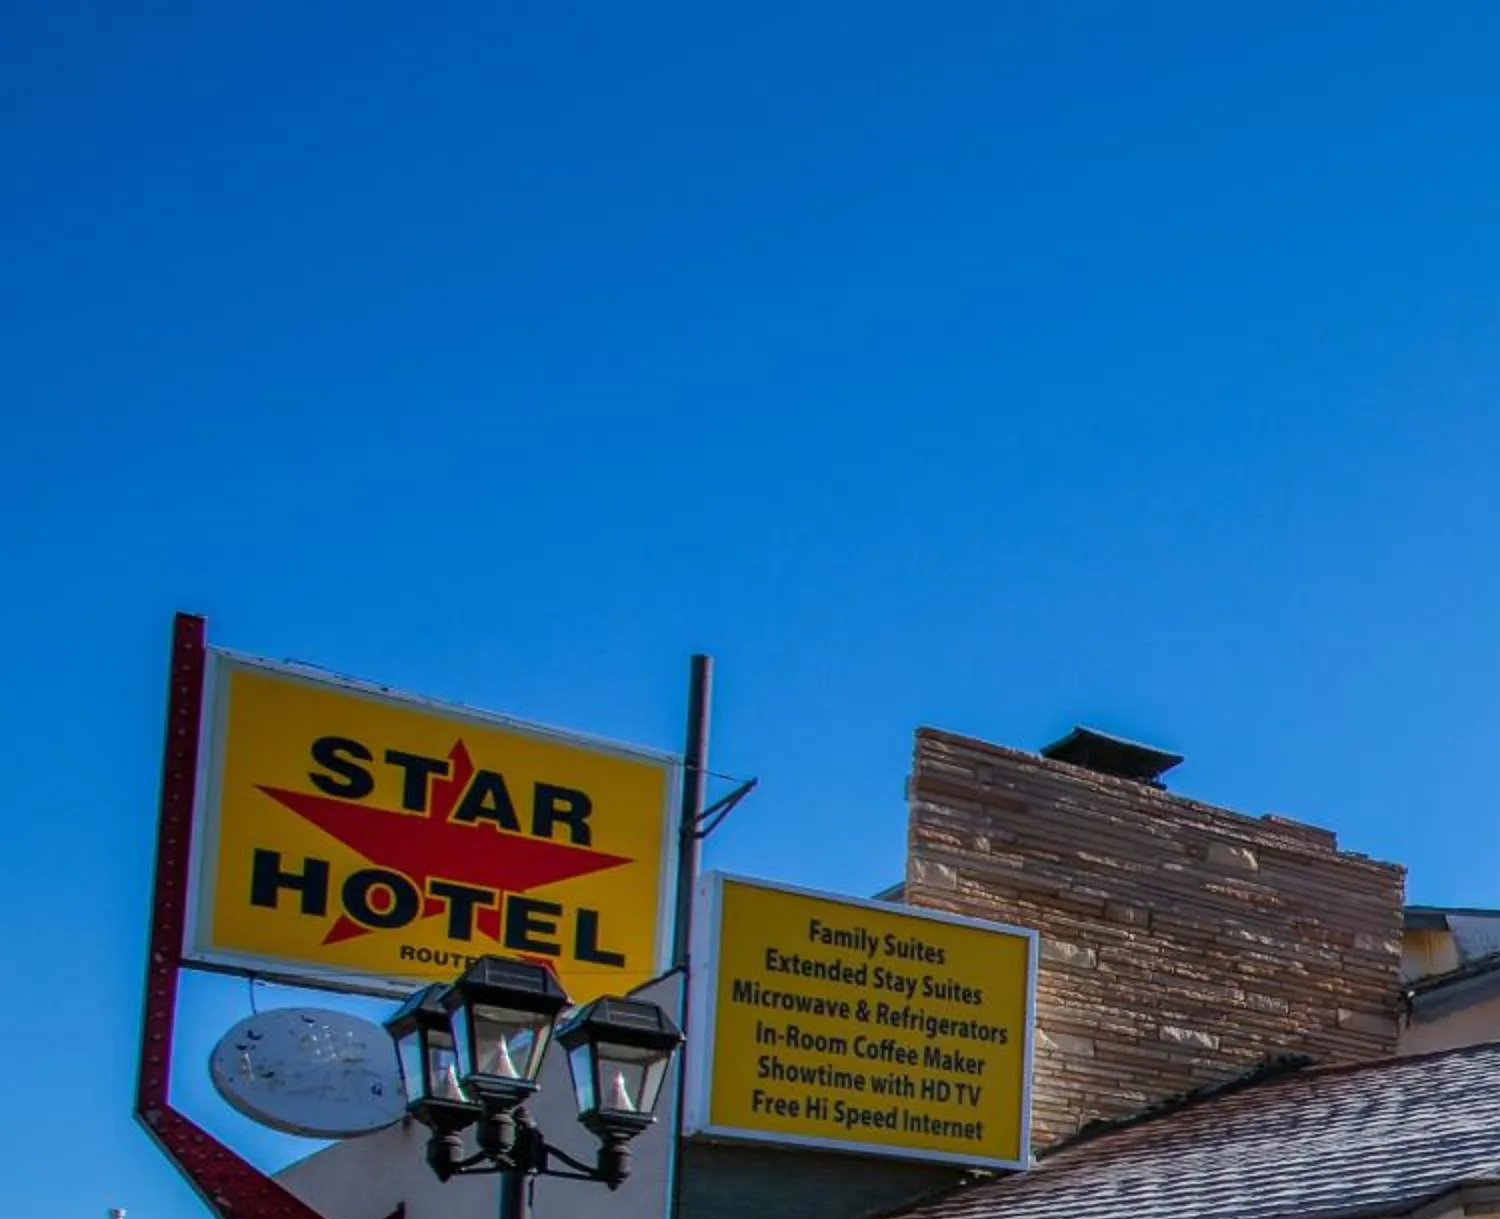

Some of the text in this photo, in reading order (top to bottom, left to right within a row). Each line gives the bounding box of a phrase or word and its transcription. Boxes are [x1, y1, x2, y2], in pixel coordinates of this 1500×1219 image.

[308, 736, 593, 847] STAR
[250, 848, 625, 968] HOTEL
[809, 919, 945, 965] Family Suites
[765, 948, 982, 1006] Extended Stay Suites
[732, 979, 1008, 1045] Microwave & Refrigerators
[755, 1021, 985, 1076] In-Room Coffee Maker
[757, 1055, 865, 1091] Showtime
[870, 1073, 915, 1100] with
[752, 1089, 983, 1141] Free Hi Speed Internet
